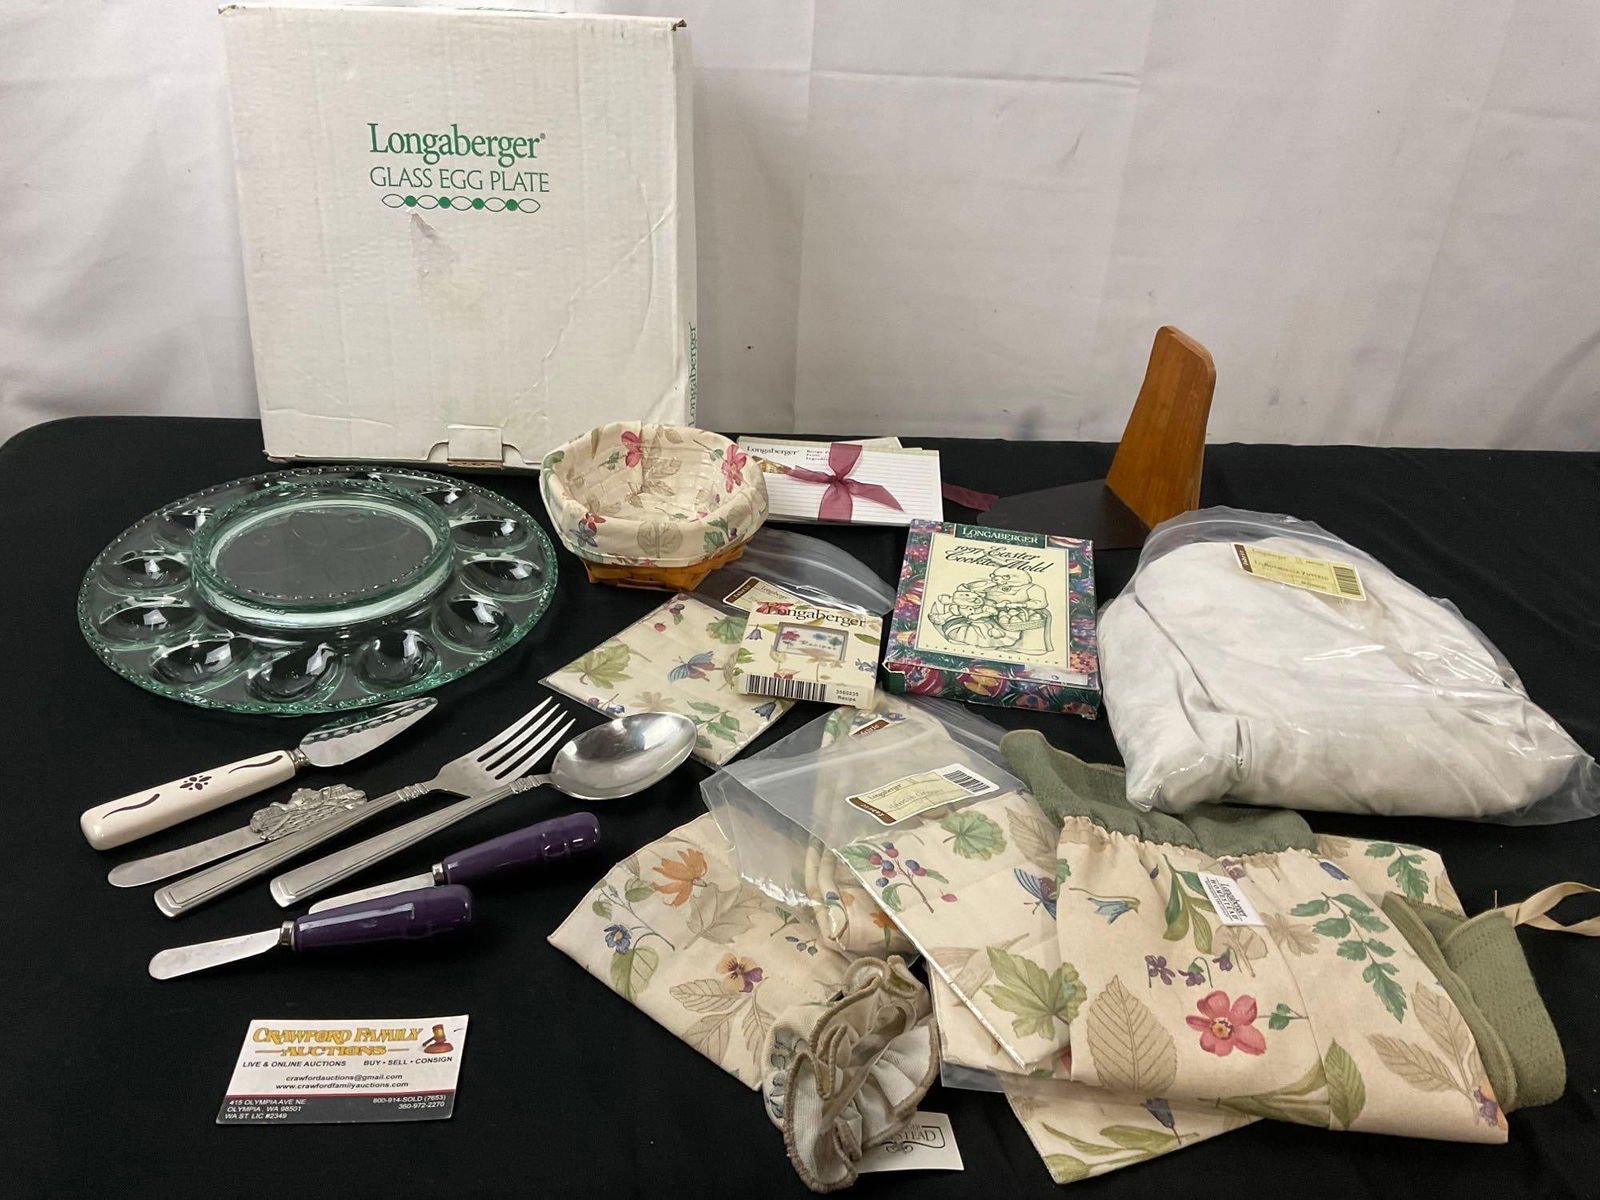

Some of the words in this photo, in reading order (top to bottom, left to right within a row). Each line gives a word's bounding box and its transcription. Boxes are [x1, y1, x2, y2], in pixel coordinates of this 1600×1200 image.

[370, 166, 433, 188] GLASS
[439, 169, 483, 190] EGG
[490, 171, 550, 192] PLATE
[962, 527, 1039, 544] LONGABERGER
[987, 545, 1041, 561] Easter
[945, 549, 997, 568] Cookie
[1000, 558, 1054, 573] Mold
[766, 605, 867, 627] Longaberger
[253, 1027, 353, 1045] CRAWFORD
[354, 1027, 423, 1043] FAMILY
[280, 1045, 387, 1057] AUCTIONS
[415, 1056, 453, 1065] CONSIGN
[286, 1073, 403, 1082] crawfordauctions@gmail.com
[275, 1081, 409, 1090] www.crawfordfamilyauctions.com
[244, 1098, 278, 1106] OLYMPIA
[224, 1112, 238, 1120] WA
